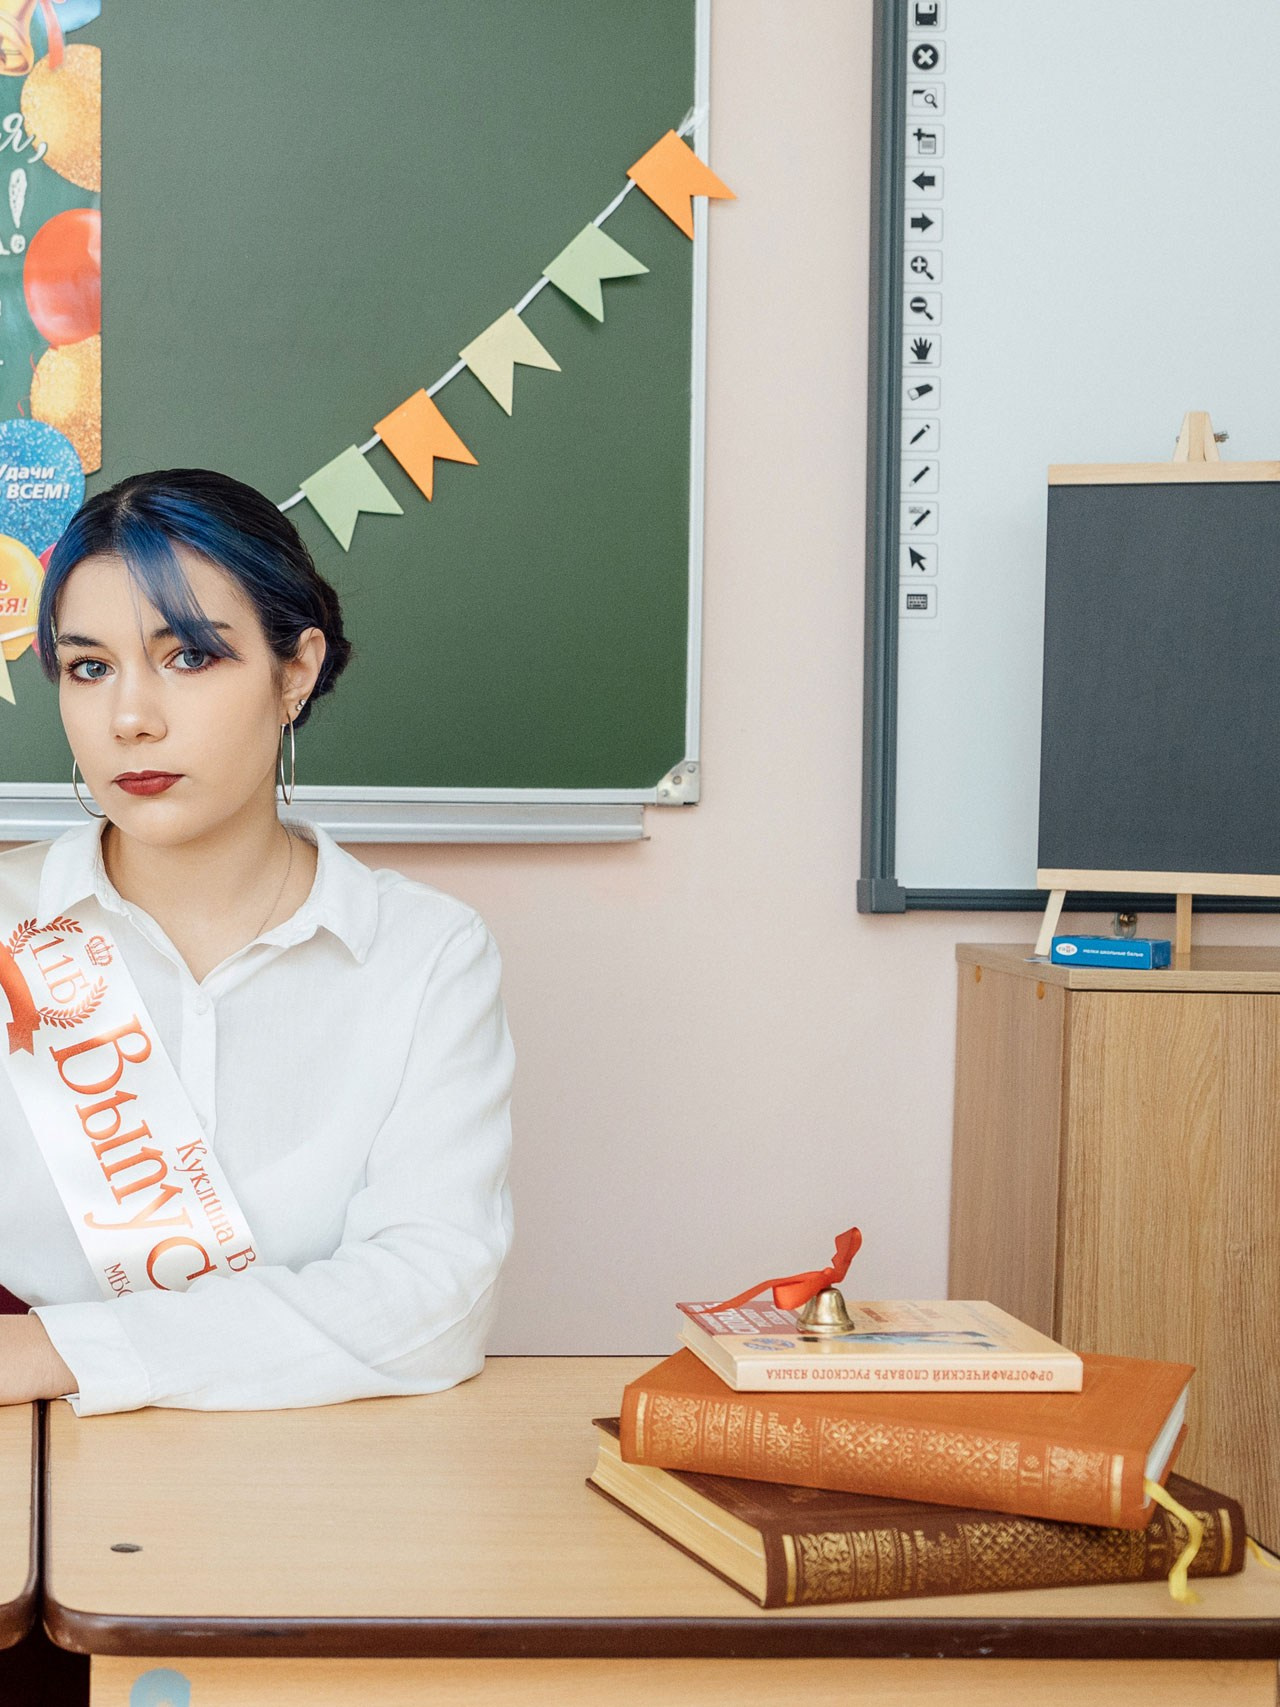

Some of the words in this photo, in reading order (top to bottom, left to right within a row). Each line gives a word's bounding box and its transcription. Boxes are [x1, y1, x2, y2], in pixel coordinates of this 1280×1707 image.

[6, 481, 71, 502] ВСЕМ!
[28, 935, 91, 1005] 11Б
[172, 1137, 238, 1247] Куклина
[765, 1367, 808, 1380] ЯЗЫКА
[811, 1368, 871, 1381] РУССКОГО
[875, 1368, 930, 1382] СЛОВАРЬ
[932, 1367, 1055, 1383] ОРФОГРАФИЧЕСКИЙ
